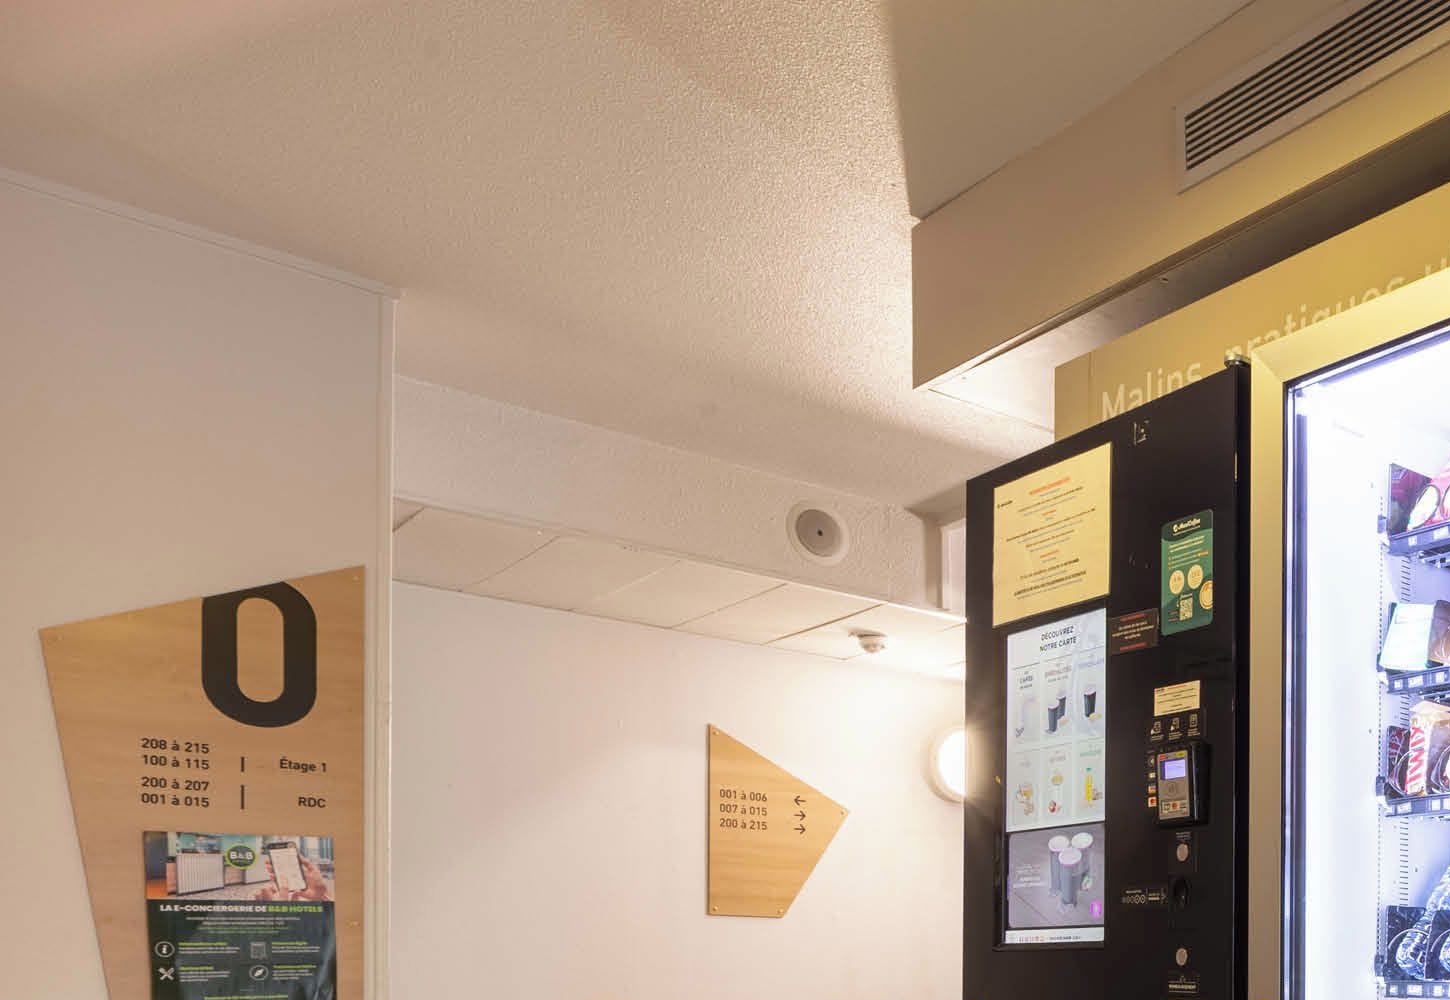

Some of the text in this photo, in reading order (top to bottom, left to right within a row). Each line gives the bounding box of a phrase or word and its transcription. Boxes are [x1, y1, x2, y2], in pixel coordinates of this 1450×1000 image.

[141, 738, 210, 754] 208 à 215
[142, 754, 210, 770] 100 à 115
[279, 756, 327, 773] Étage 1
[141, 776, 210, 791] 200 à 207
[141, 793, 210, 808] 001 à 015
[298, 796, 326, 808] RDC
[719, 789, 768, 802] 001 à 006
[719, 803, 768, 816] 007 à 015
[719, 818, 768, 831] 200 à 215
